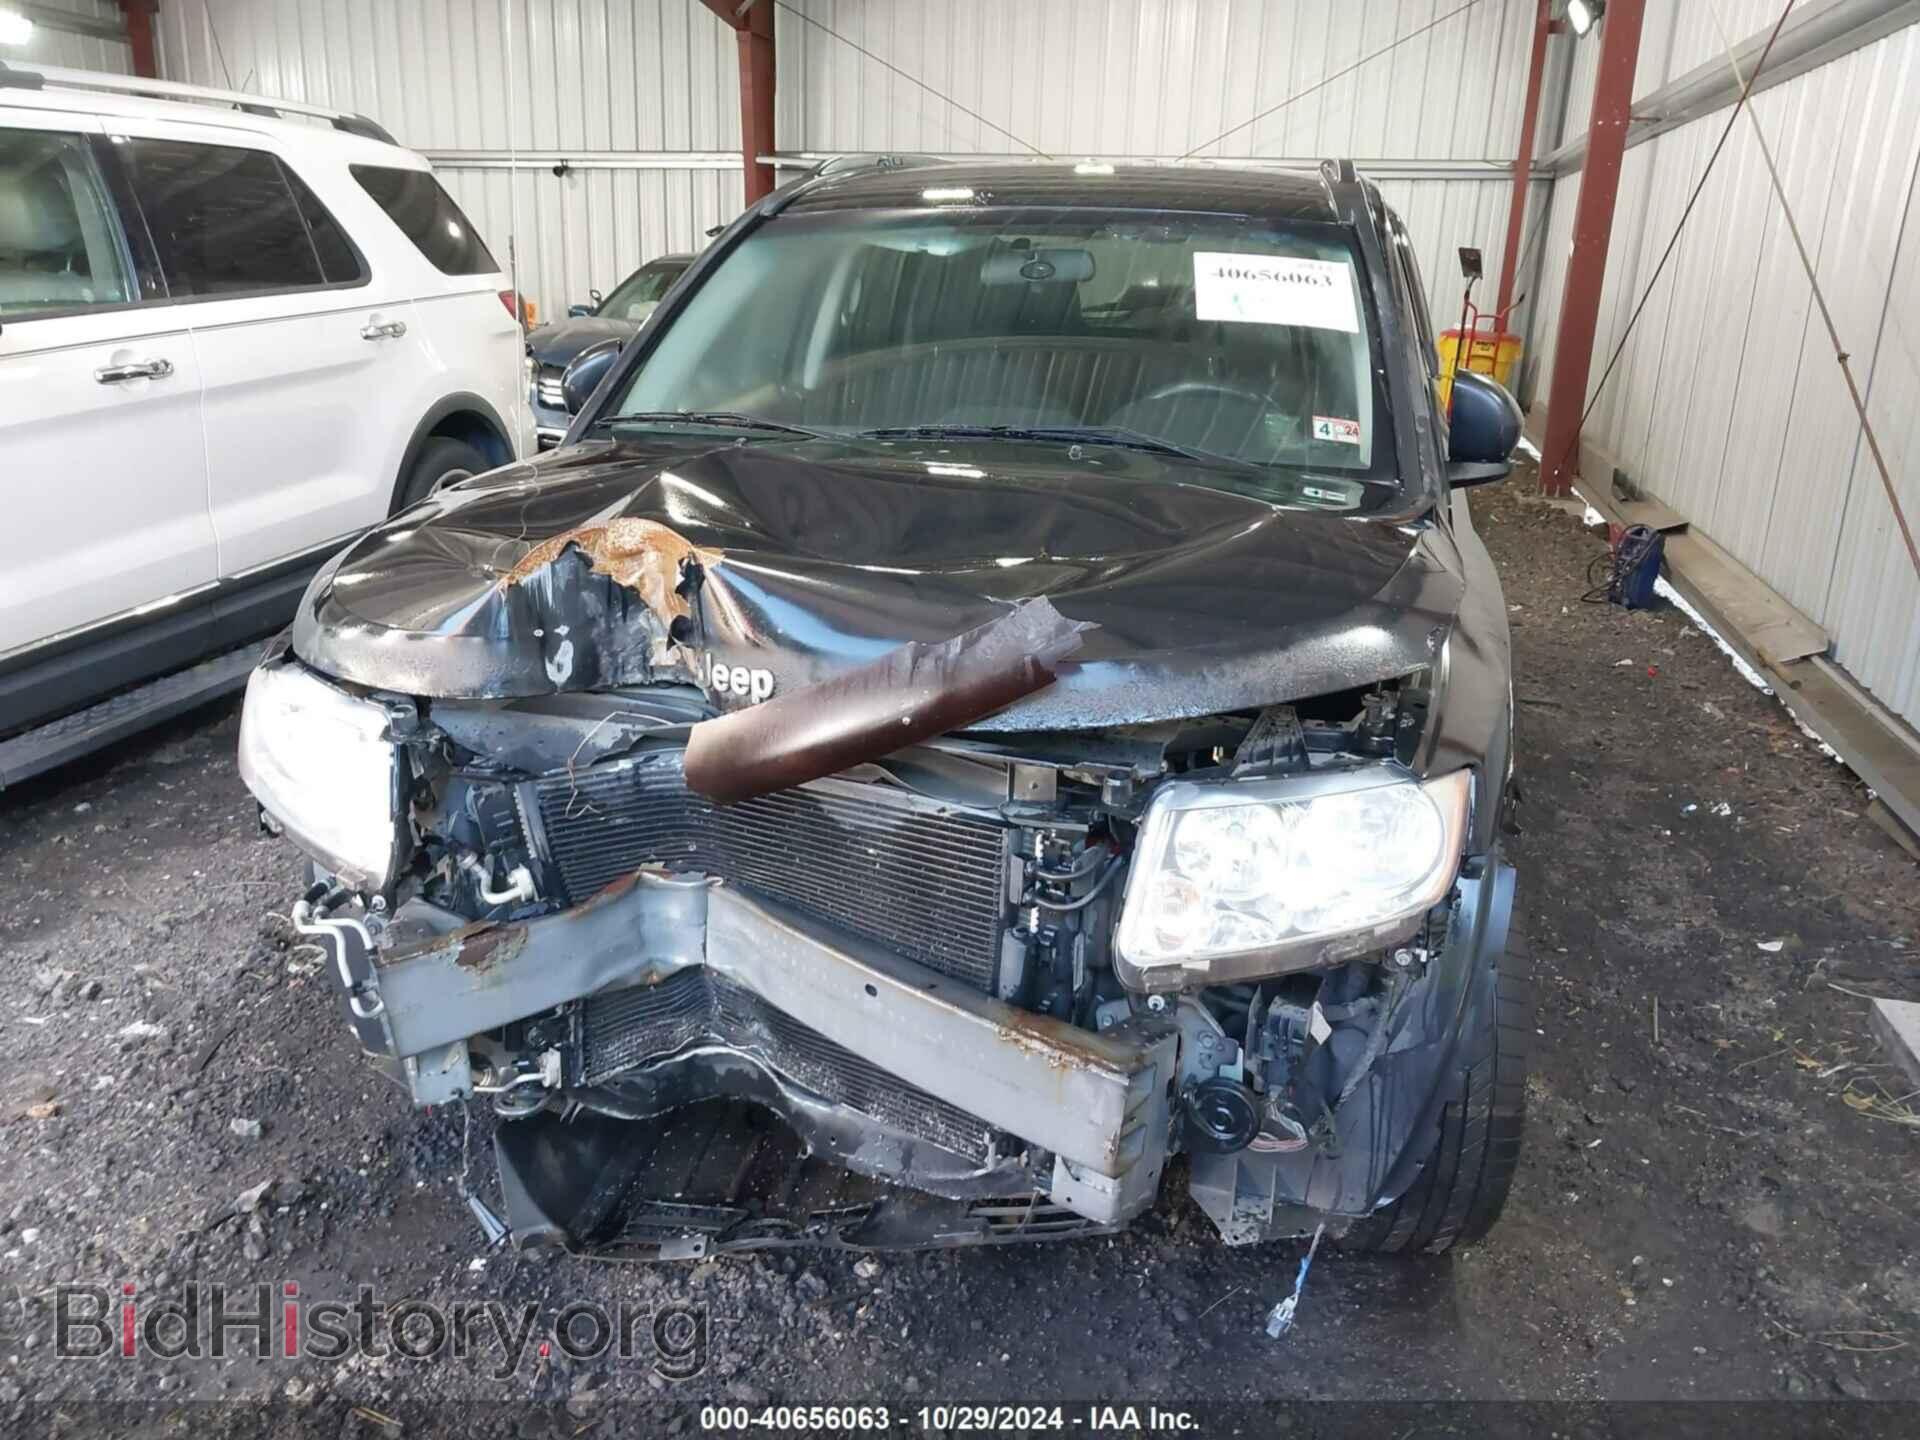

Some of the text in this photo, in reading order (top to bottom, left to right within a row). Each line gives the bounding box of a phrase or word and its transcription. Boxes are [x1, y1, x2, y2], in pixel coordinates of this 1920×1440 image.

[1210, 267, 1332, 287] 40656063
[1319, 423, 1331, 436] 4
[698, 652, 774, 704] Jeep
